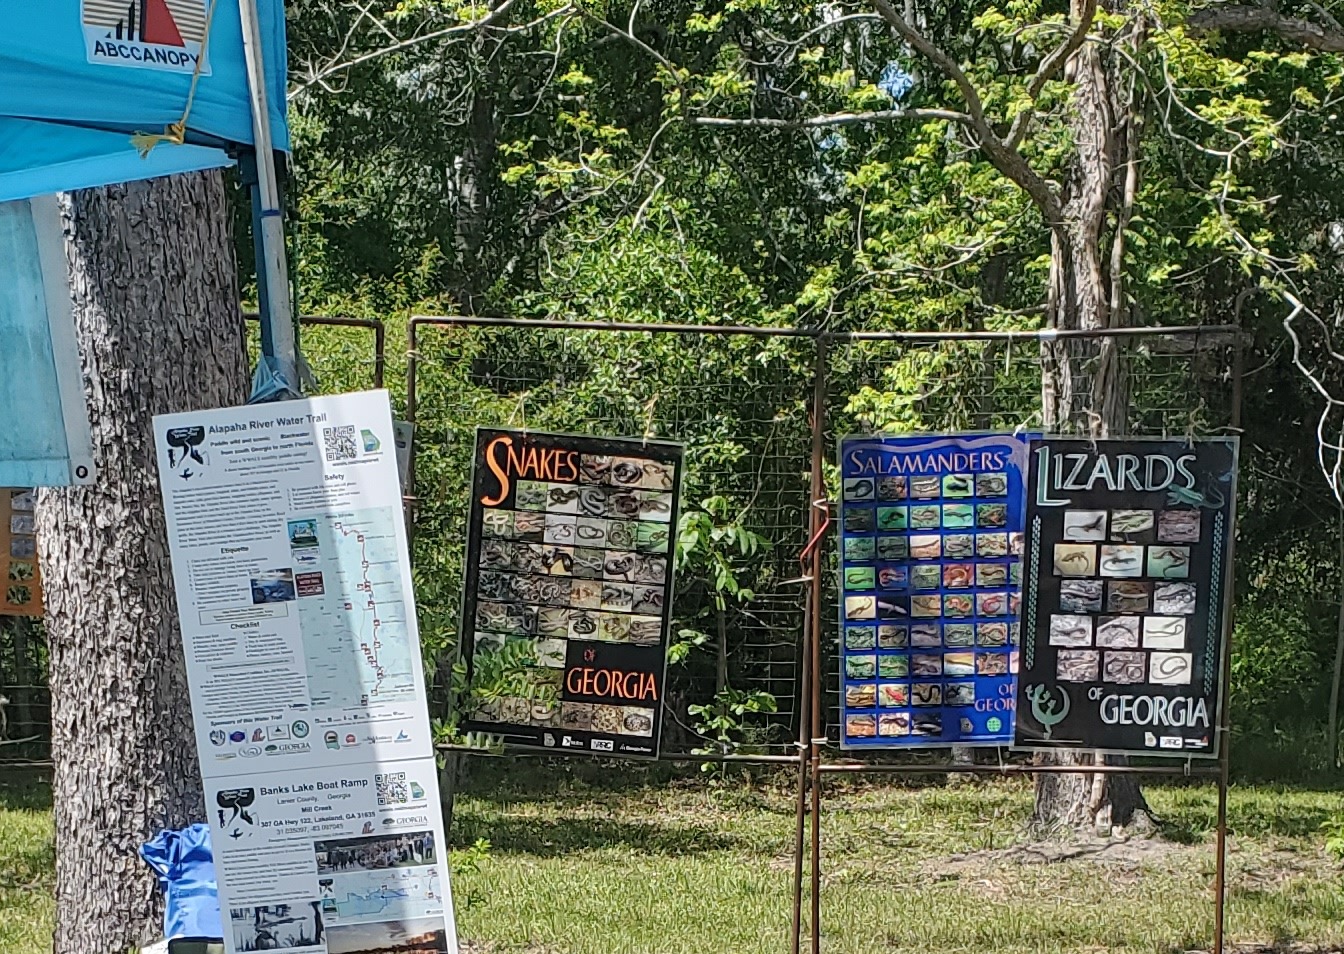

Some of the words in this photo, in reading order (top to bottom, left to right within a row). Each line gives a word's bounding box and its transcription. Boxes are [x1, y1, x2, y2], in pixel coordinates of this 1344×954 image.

[93, 39, 202, 67] ABCCANOPY
[208, 420, 247, 435] Alapaha
[249, 417, 274, 430] River
[276, 416, 305, 427] Water
[306, 413, 327, 424] Trail
[480, 435, 579, 506] SNAKES
[850, 449, 1005, 475] SALAMANDERS
[1034, 446, 1197, 507] LIZARDS
[566, 667, 658, 701] GEORGIA
[1088, 686, 1104, 701] OF
[974, 697, 1016, 713] GEOR
[1099, 694, 1210, 728] GEORGIA
[260, 786, 290, 796] Banks
[292, 783, 315, 793] Lake
[316, 781, 339, 791] Boat
[340, 778, 368, 788] Ramp
